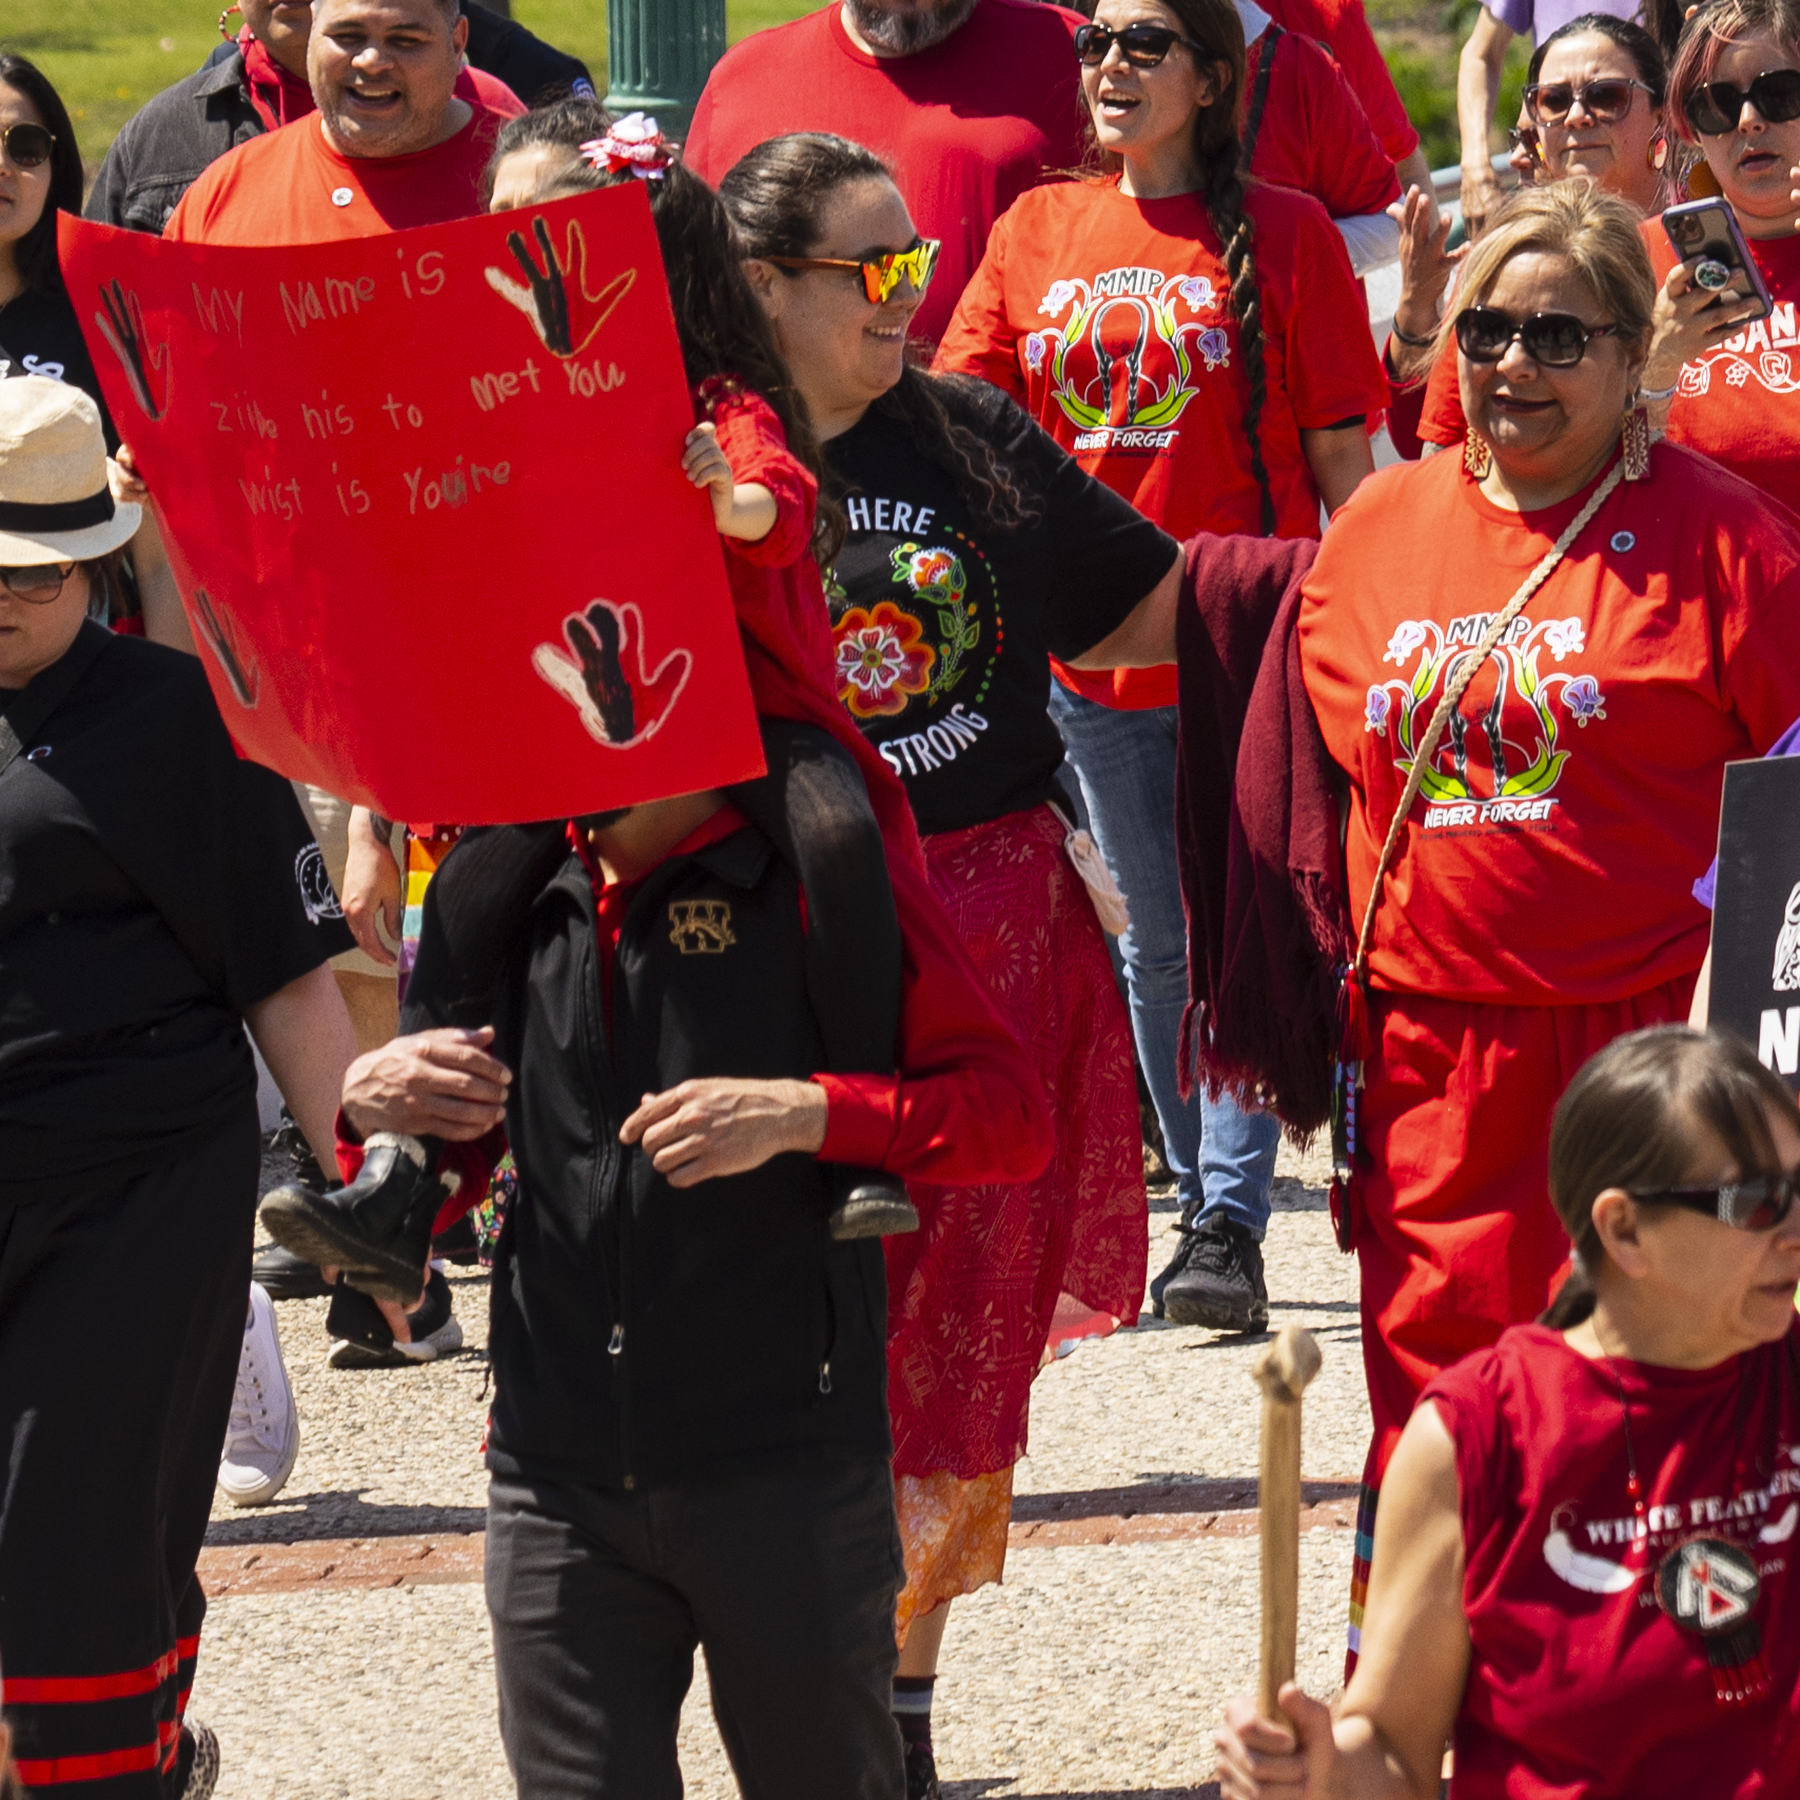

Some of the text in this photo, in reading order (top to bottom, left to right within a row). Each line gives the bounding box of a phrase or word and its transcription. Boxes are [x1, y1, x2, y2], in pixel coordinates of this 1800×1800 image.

[1092, 266, 1166, 298] MMIP
[381, 392, 424, 431] to
[1074, 429, 1180, 451] NEVER FORGET
[847, 497, 936, 536] HERE
[1446, 611, 1533, 646] MMP
[878, 702, 989, 777] STRONG
[1424, 798, 1560, 830] NEVER FORGET
